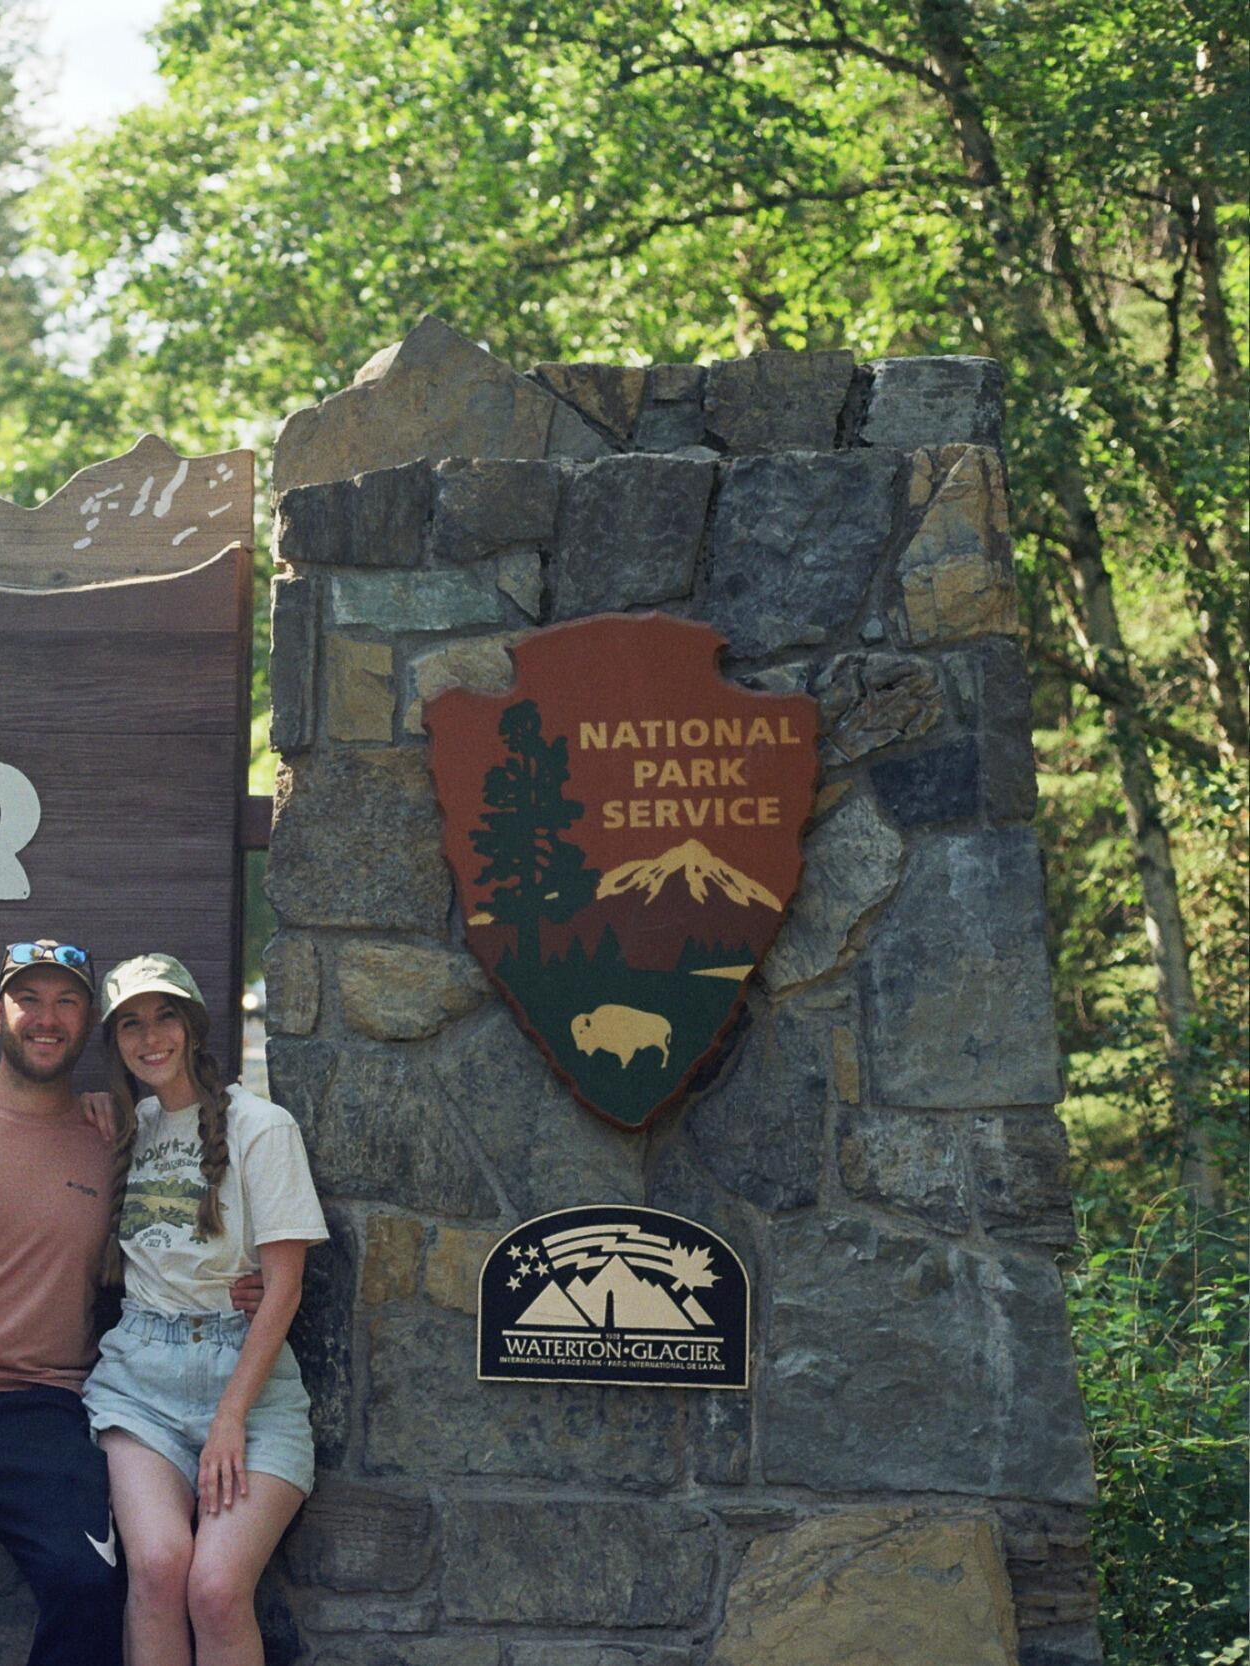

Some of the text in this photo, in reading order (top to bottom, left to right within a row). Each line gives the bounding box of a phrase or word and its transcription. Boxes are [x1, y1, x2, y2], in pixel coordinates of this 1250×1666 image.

[579, 717, 800, 750] NATIONAL
[633, 757, 747, 788] PARK
[602, 797, 781, 829] SERVICE
[499, 1356, 556, 1366] INTERNATIONAL
[557, 1358, 581, 1367] PEACE
[582, 1359, 602, 1368] PARK
[629, 1361, 686, 1370] INTERNATIONAL
[698, 1363, 709, 1371] LA
